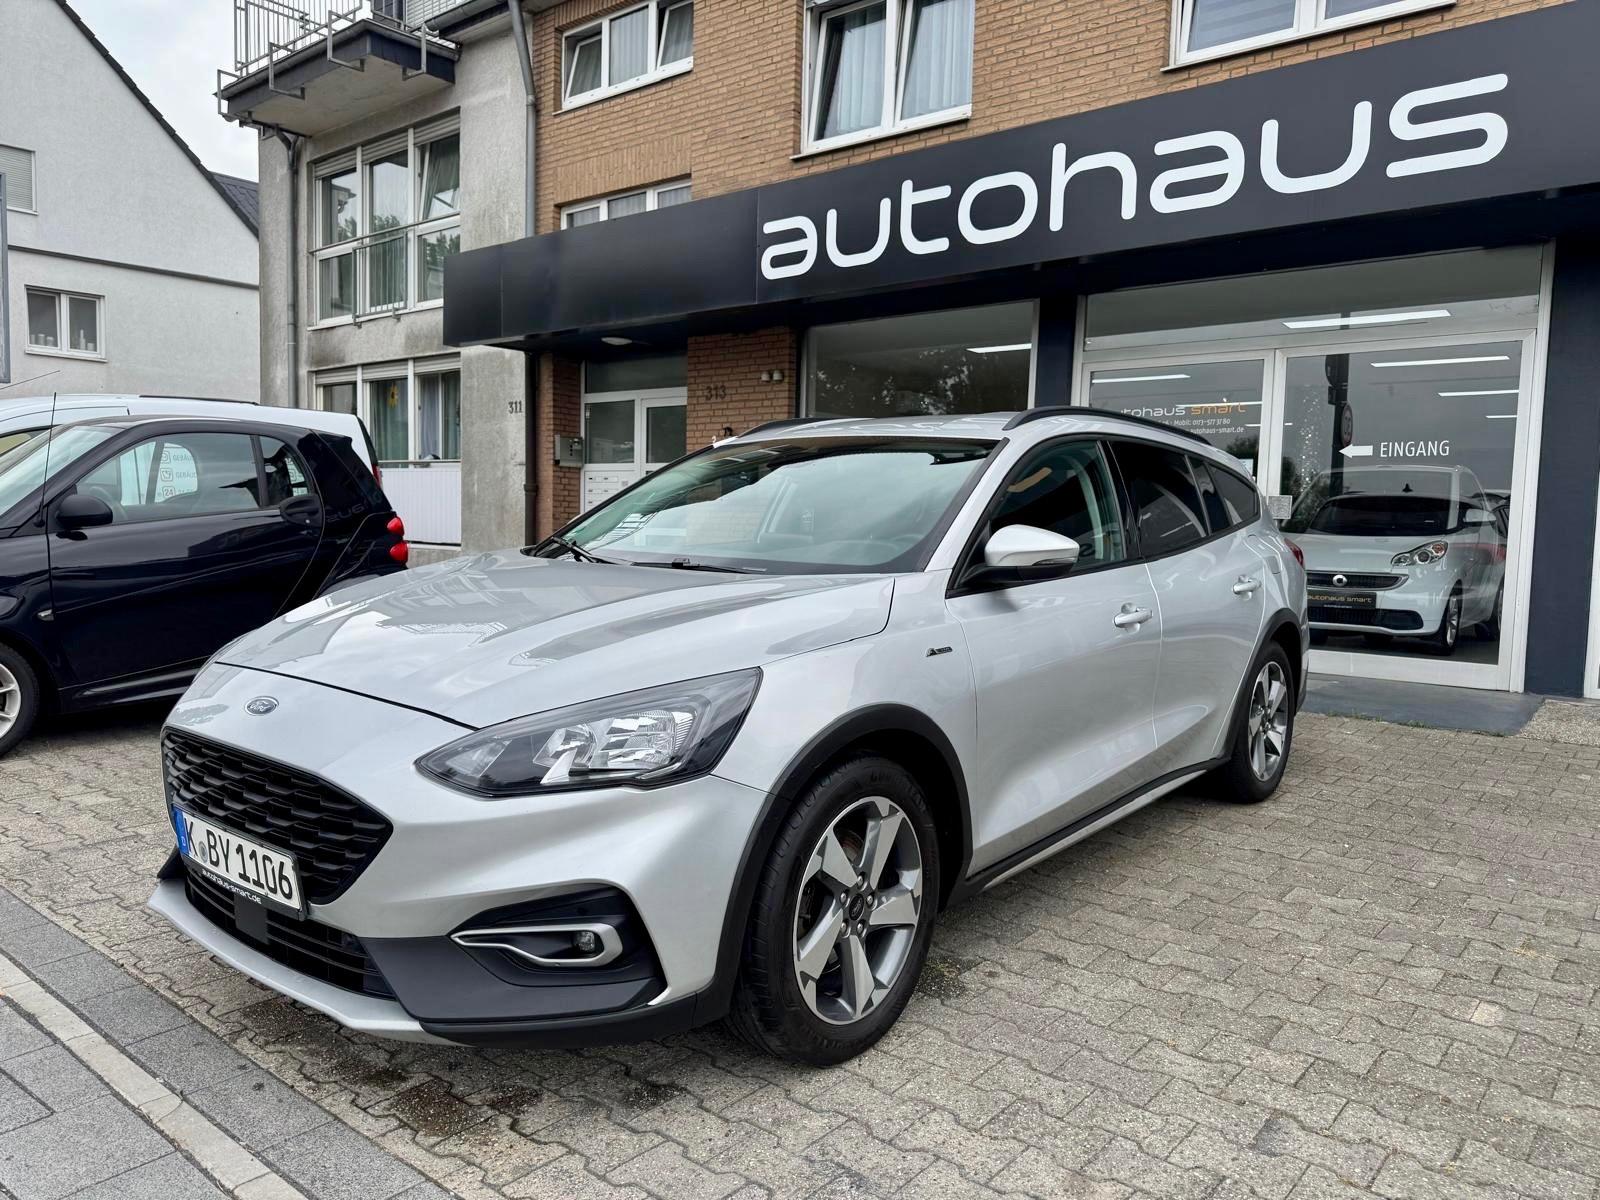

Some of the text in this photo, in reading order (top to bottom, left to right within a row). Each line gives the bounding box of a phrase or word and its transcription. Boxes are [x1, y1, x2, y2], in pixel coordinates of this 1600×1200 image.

[760, 73, 1508, 281] autohaus
[705, 385, 727, 399] 313
[508, 401, 523, 414] 311
[1120, 403, 1246, 417] tohaus smart
[1190, 426, 1244, 434] autohaus-smart.de
[1380, 440, 1450, 458] EINGANG
[184, 818, 293, 900] K BY 1106
